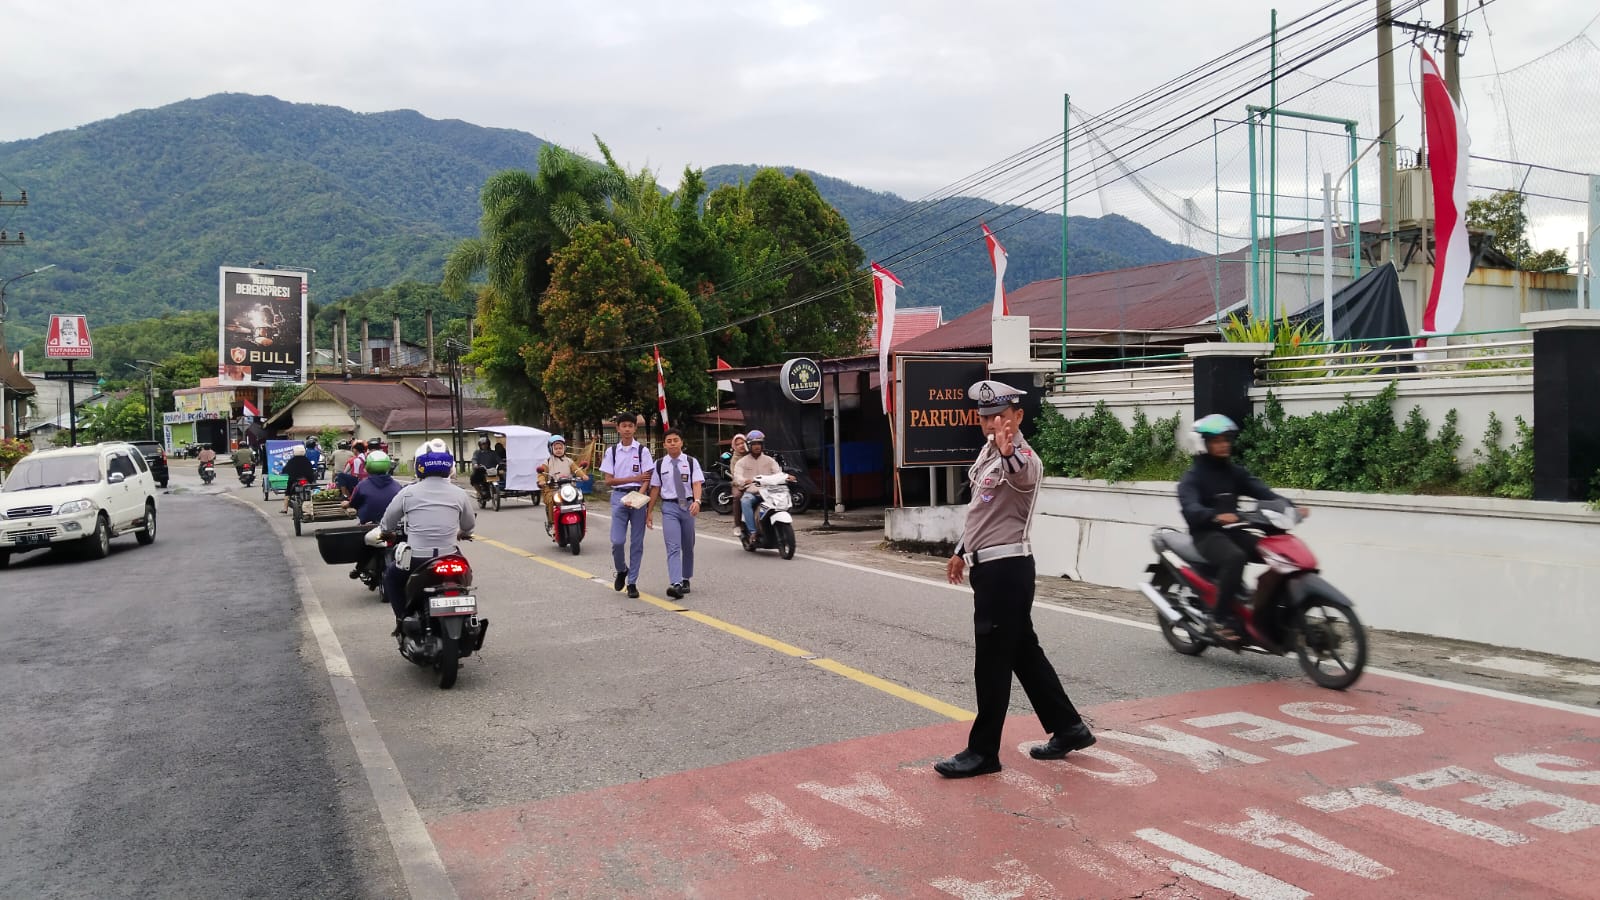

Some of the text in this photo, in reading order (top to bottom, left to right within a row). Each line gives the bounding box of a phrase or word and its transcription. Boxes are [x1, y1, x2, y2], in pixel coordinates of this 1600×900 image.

[236, 283, 290, 298] BEREKSPRESI
[250, 351, 295, 364] BULL
[928, 388, 964, 400] PARIS
